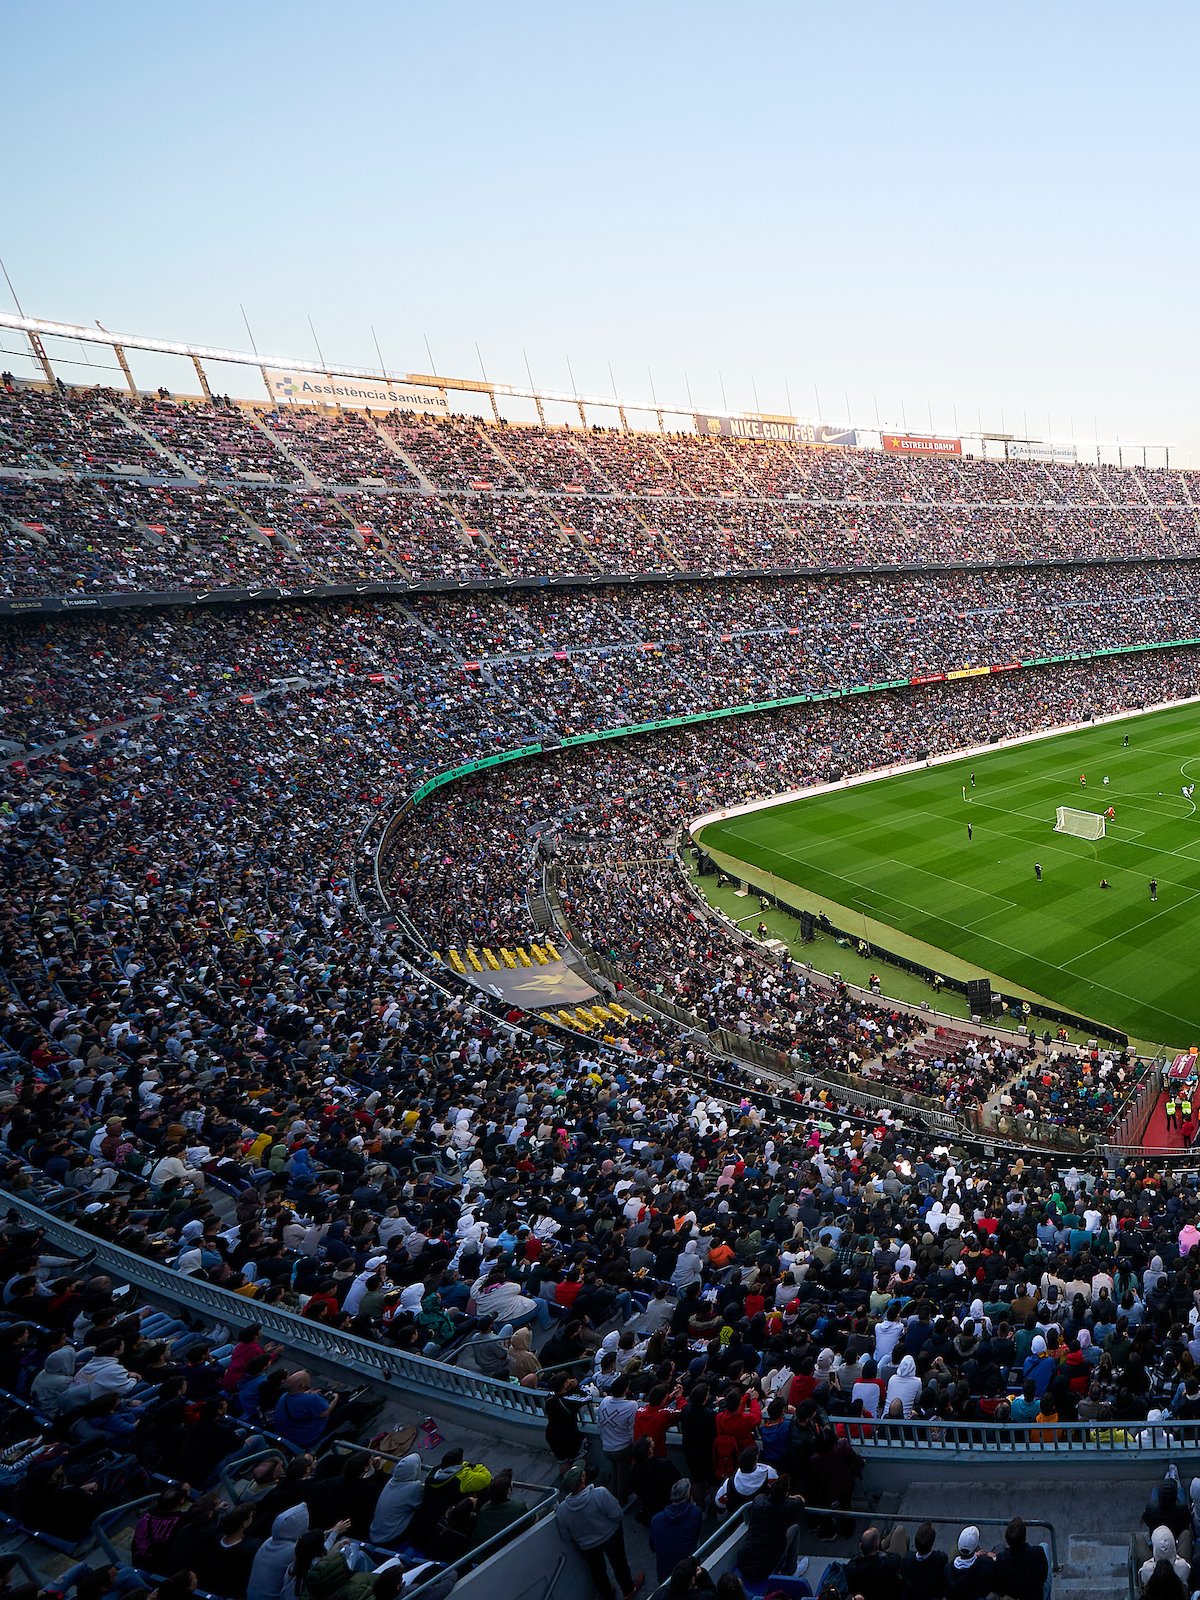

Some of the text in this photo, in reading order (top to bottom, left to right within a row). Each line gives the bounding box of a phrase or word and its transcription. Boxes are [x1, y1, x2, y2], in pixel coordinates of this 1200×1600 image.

[302, 381, 447, 407] Assistència Sanitària
[729, 420, 815, 442] NIKE.COM/FCB
[901, 440, 955, 451] ESTRELLA DAMM
